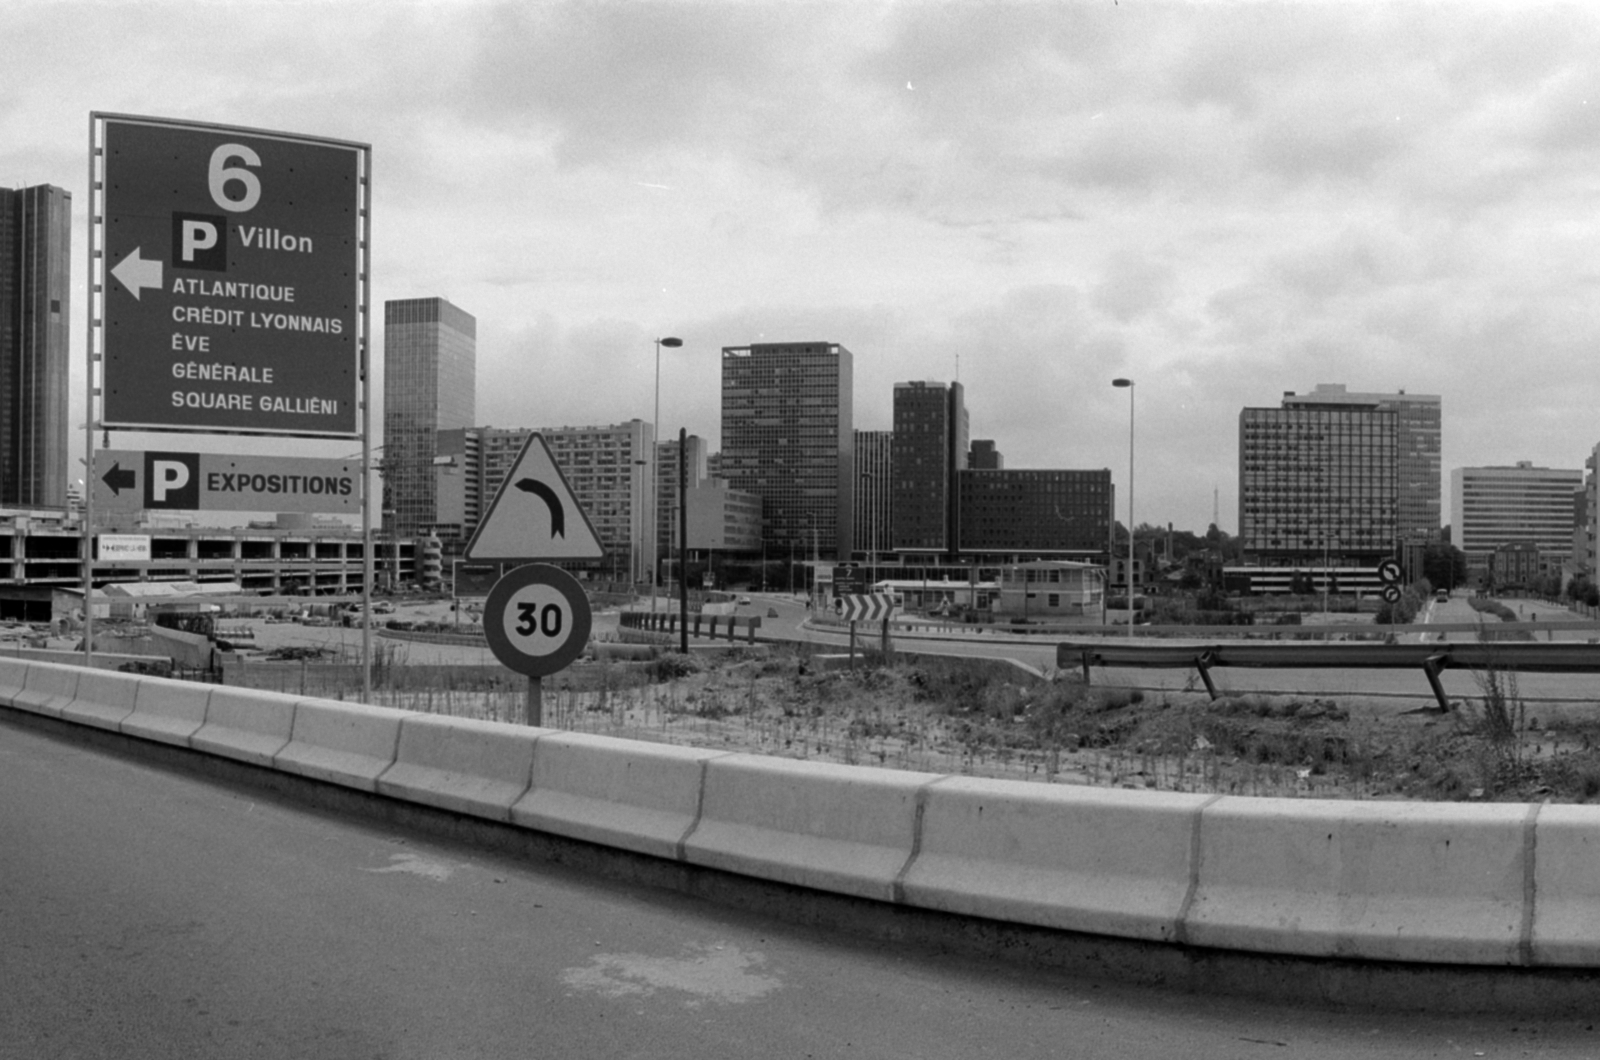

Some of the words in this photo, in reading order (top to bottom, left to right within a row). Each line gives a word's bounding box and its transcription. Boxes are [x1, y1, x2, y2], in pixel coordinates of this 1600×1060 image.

[208, 143, 262, 213] 6
[182, 219, 218, 262] P
[238, 225, 313, 253] Villon
[172, 278, 295, 302] ATLANTIQUE
[251, 311, 343, 334] LYONNAIS
[171, 391, 253, 411] SQUARE
[152, 459, 190, 502] P
[207, 472, 352, 496] EXPOSITIONS
[515, 602, 562, 638] 30
